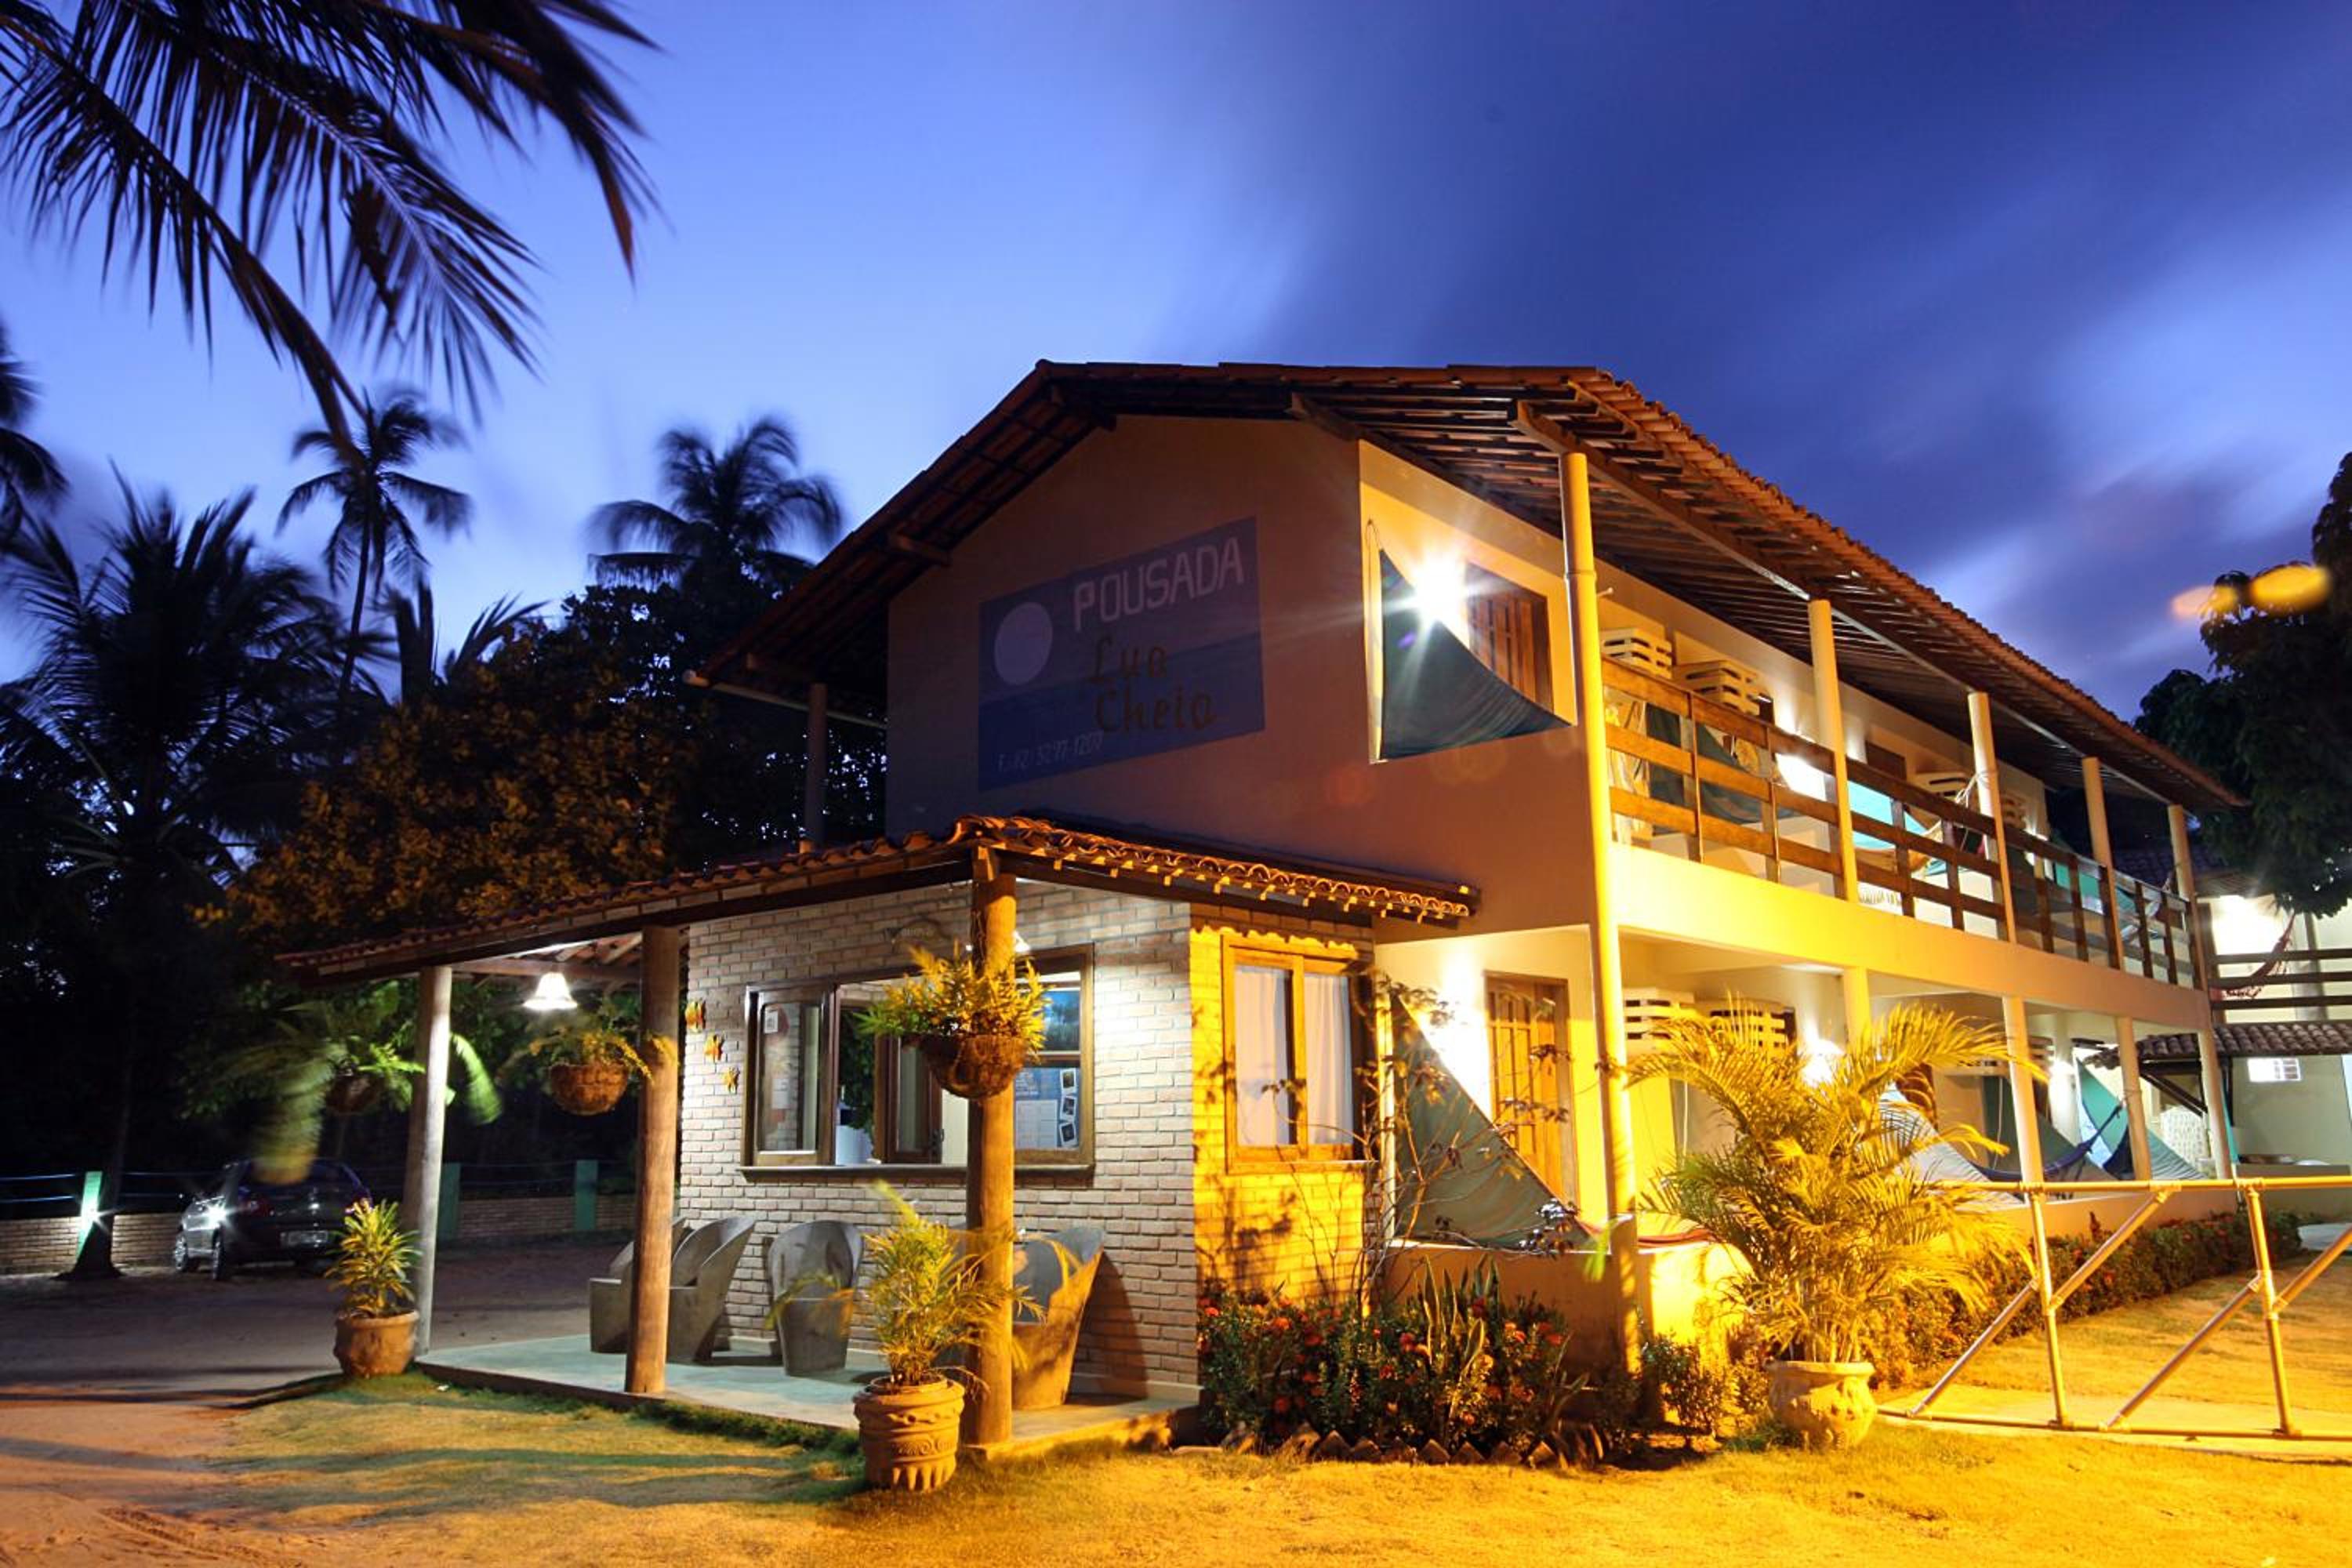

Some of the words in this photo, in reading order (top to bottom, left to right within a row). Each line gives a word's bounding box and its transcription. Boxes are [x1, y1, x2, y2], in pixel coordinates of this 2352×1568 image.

[1073, 536, 1245, 632] POUSADA
[1088, 634, 1169, 681] Lua
[1094, 682, 1214, 732] Cheia
